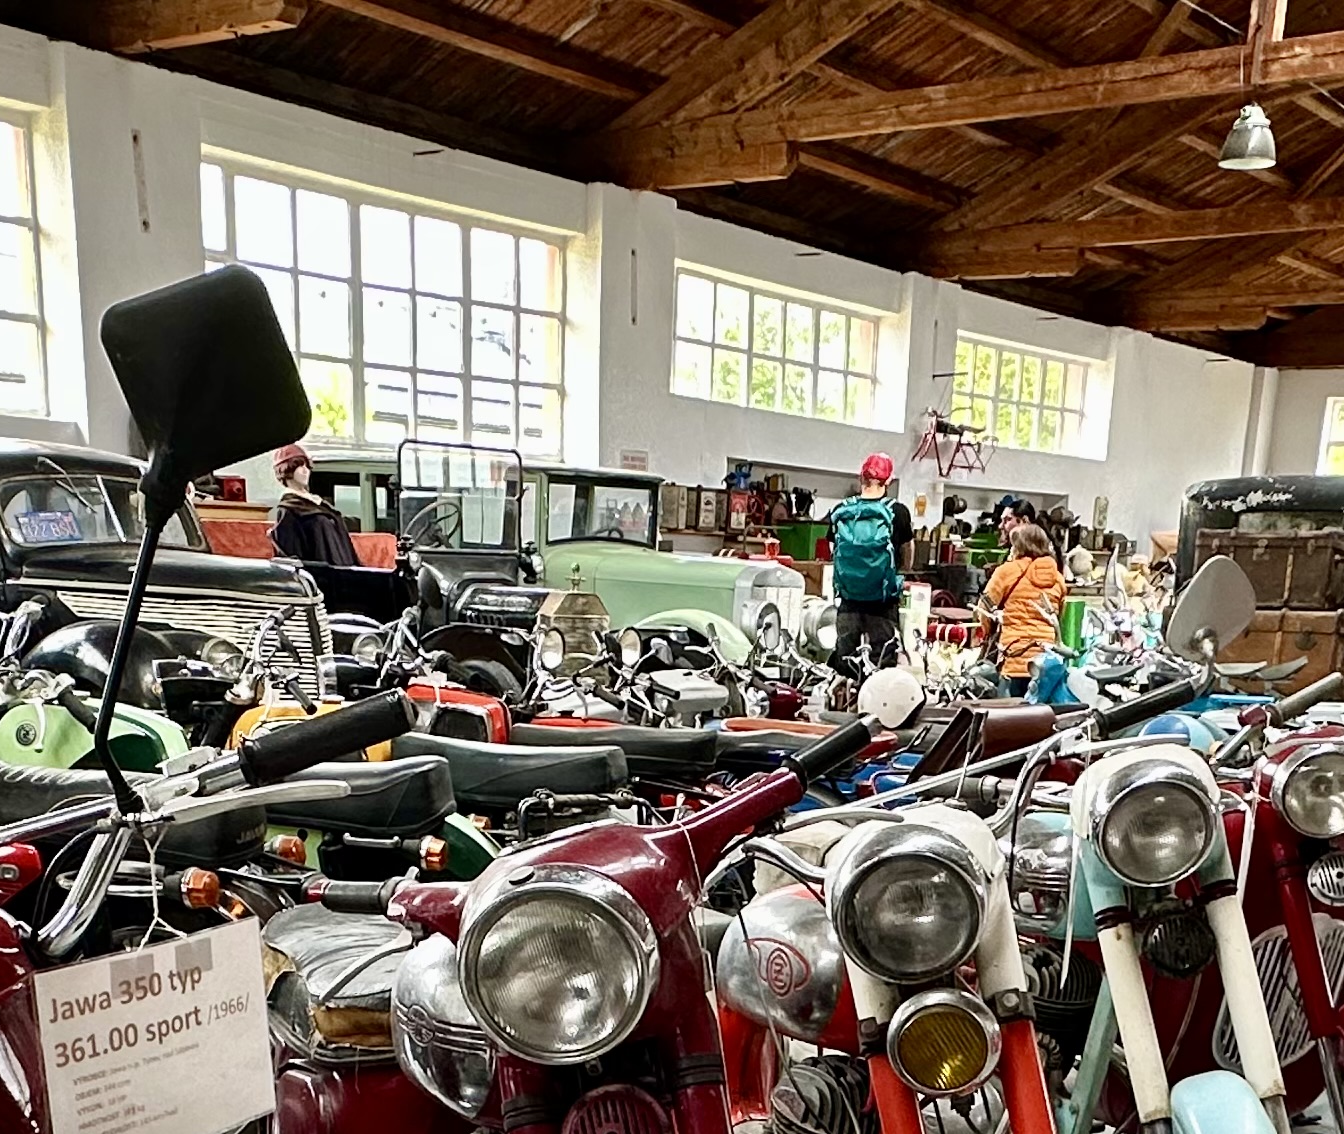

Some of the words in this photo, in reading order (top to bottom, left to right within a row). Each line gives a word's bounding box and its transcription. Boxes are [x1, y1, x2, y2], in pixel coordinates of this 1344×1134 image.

[49, 989, 112, 1024] Jawa
[118, 970, 163, 1005] 350
[168, 965, 203, 993] typ
[54, 1022, 139, 1069] 361.00
[145, 1004, 203, 1044] sport
[207, 991, 251, 1025] /1966/
